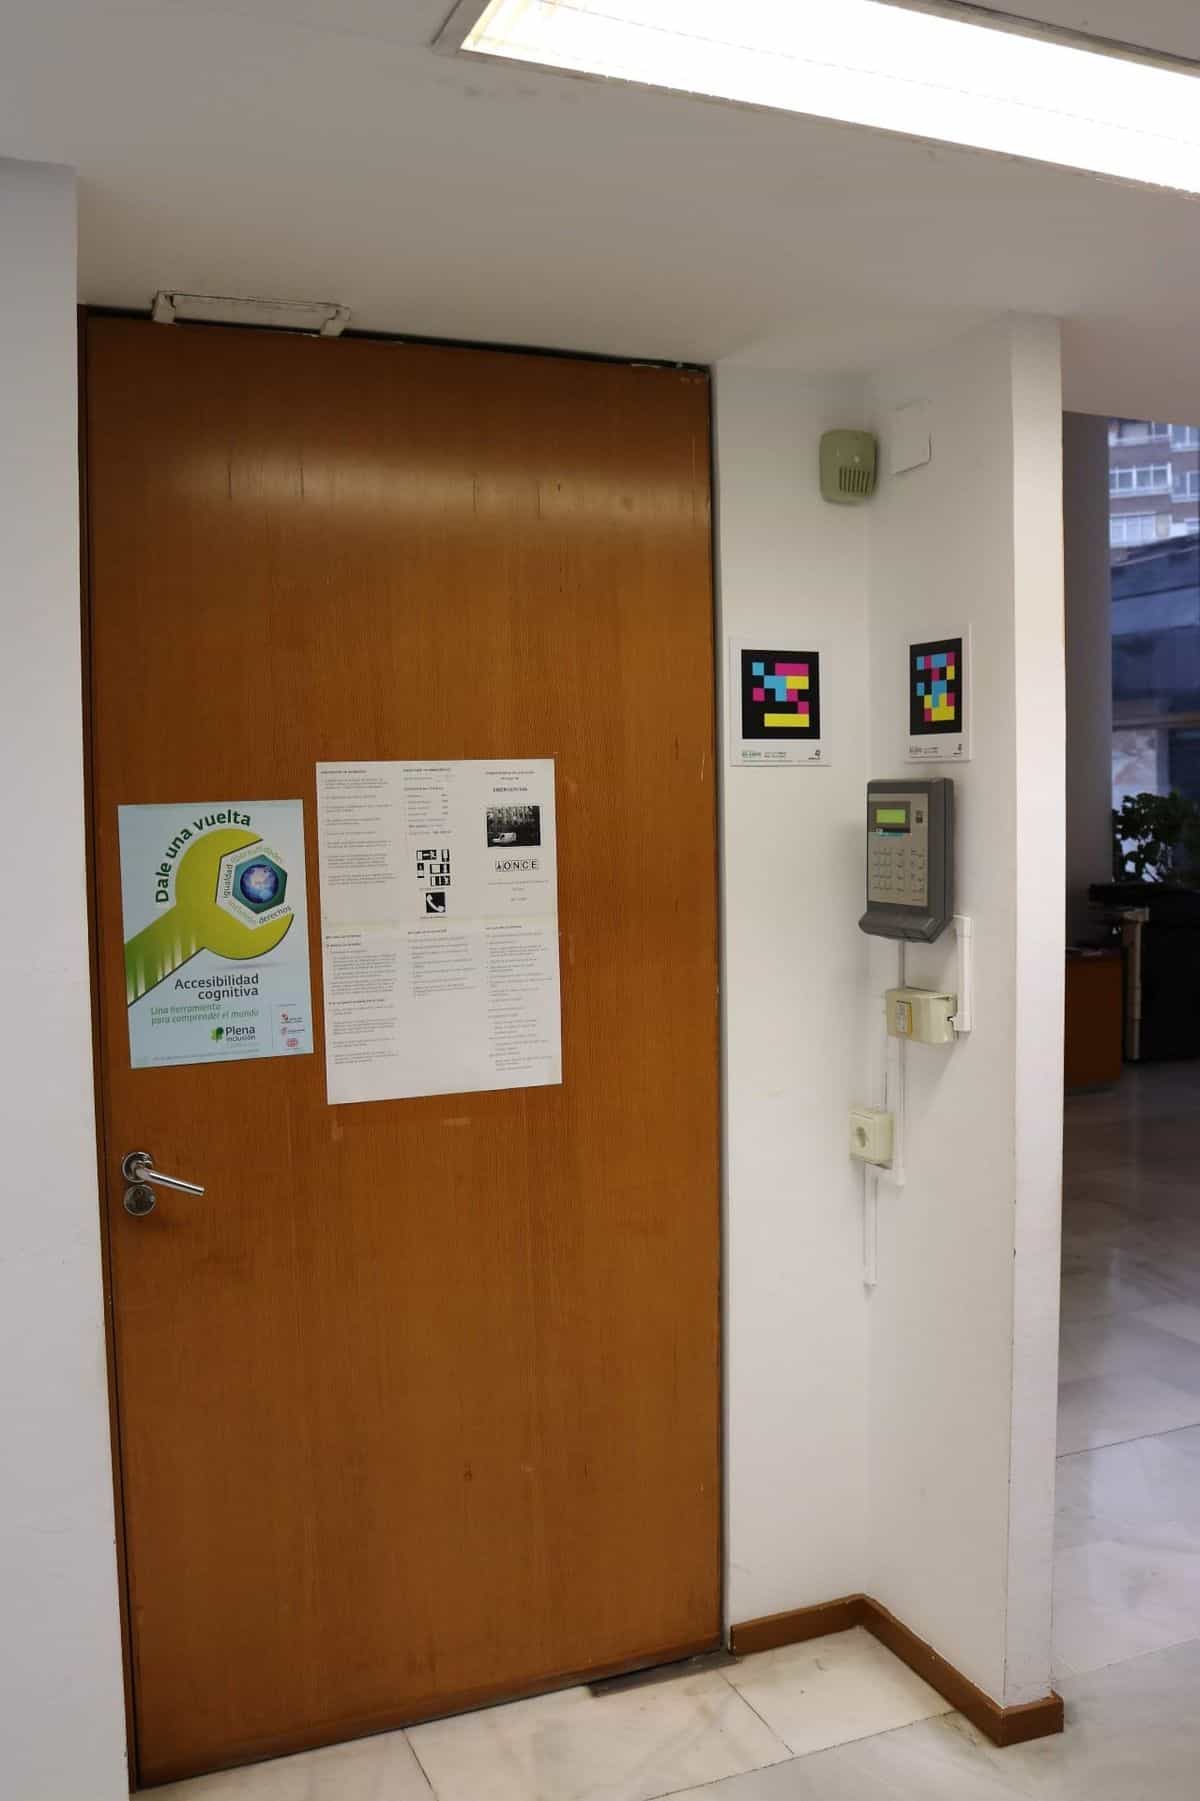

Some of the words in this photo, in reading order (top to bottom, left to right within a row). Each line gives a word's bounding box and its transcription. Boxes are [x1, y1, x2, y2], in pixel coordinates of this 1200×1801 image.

[155, 862, 172, 903] Dale
[165, 828, 193, 859] una
[193, 809, 251, 831] vuelta
[503, 860, 537, 870] ONCE
[174, 973, 259, 990] Accesibilidad
[198, 986, 259, 1001] cognitiva
[151, 1016, 170, 1026] para
[171, 1013, 219, 1025] comprender
[225, 1026, 256, 1036] Plena
